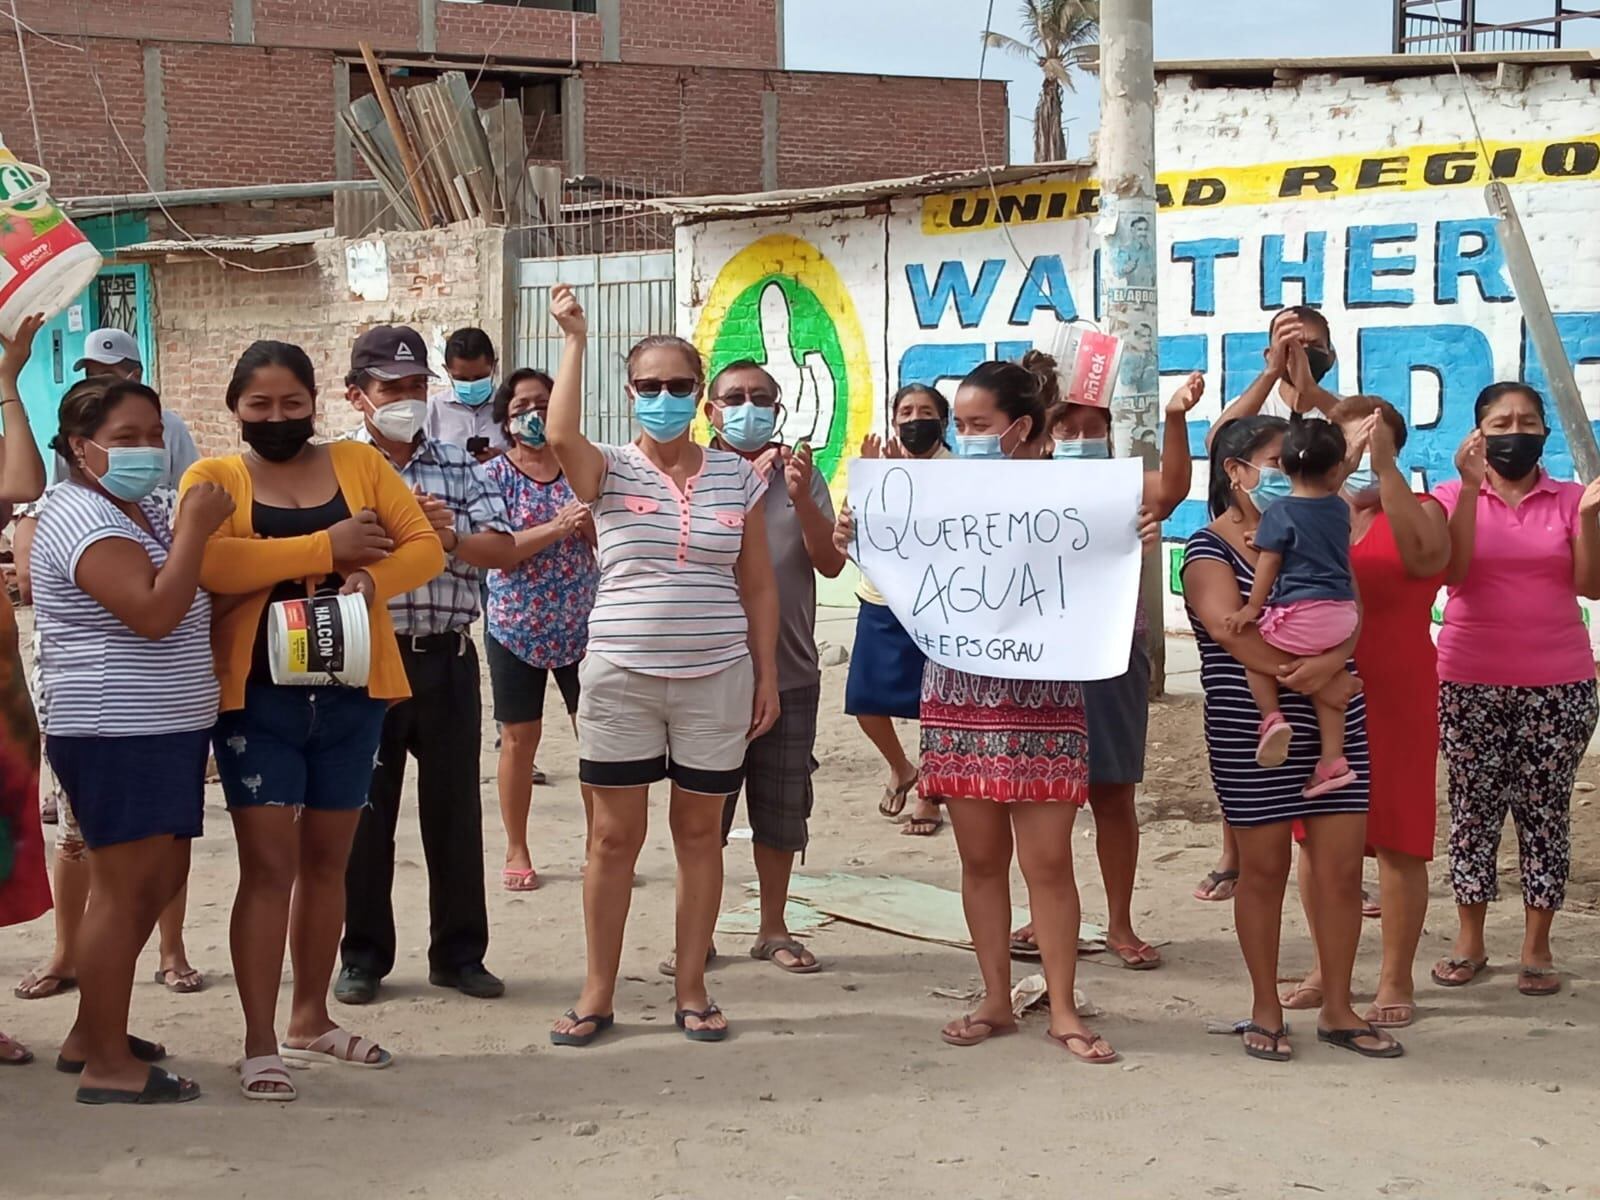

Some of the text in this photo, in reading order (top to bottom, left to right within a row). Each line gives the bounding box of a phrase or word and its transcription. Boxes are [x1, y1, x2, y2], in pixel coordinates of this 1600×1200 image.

[1278, 142, 1600, 197] REGIO
[904, 217, 1516, 330] WATHER
[1084, 352, 1106, 401] Pintek
[911, 555, 1067, 626] AGUA!
[314, 606, 334, 657] HALCON
